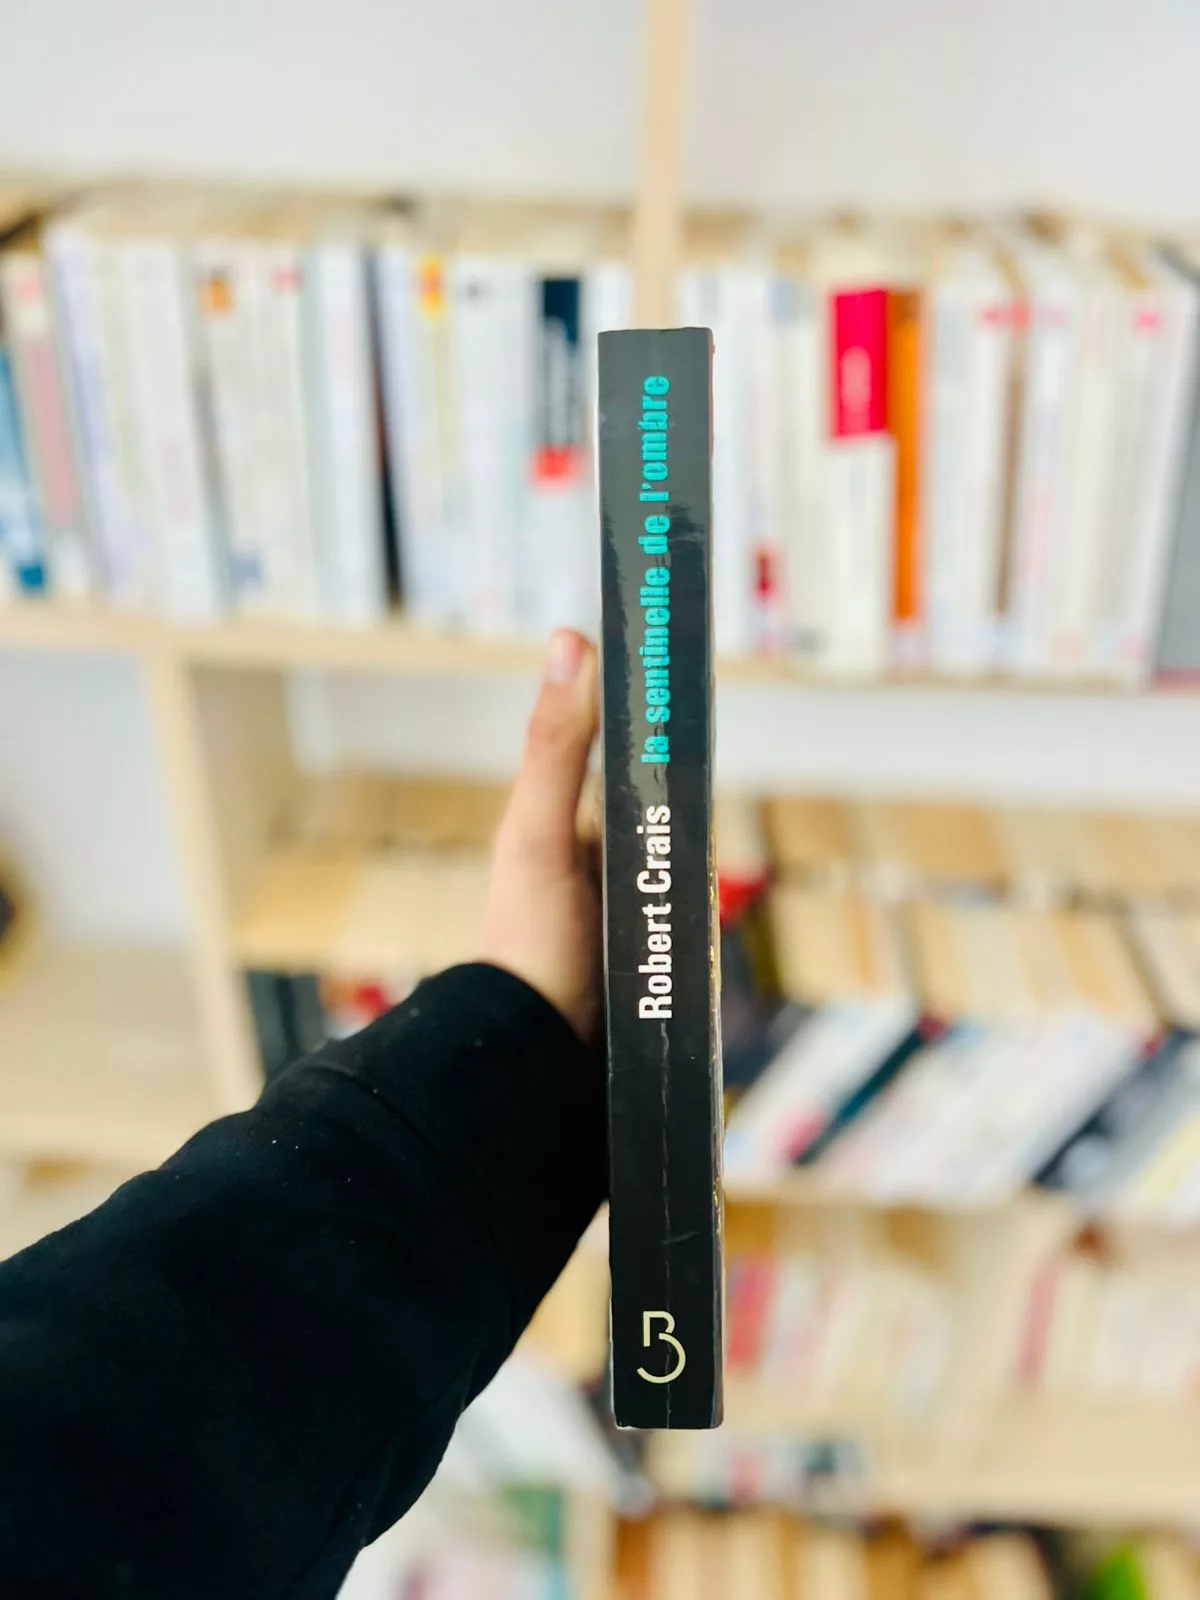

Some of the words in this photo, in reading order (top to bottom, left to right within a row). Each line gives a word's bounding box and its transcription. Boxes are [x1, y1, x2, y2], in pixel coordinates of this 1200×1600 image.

[638, 375, 670, 503] l'ombre
[638, 514, 671, 555] de
[639, 566, 671, 724] sentinelle
[640, 734, 670, 764] la
[636, 804, 672, 894] Crais
[638, 902, 673, 1020] Robert
